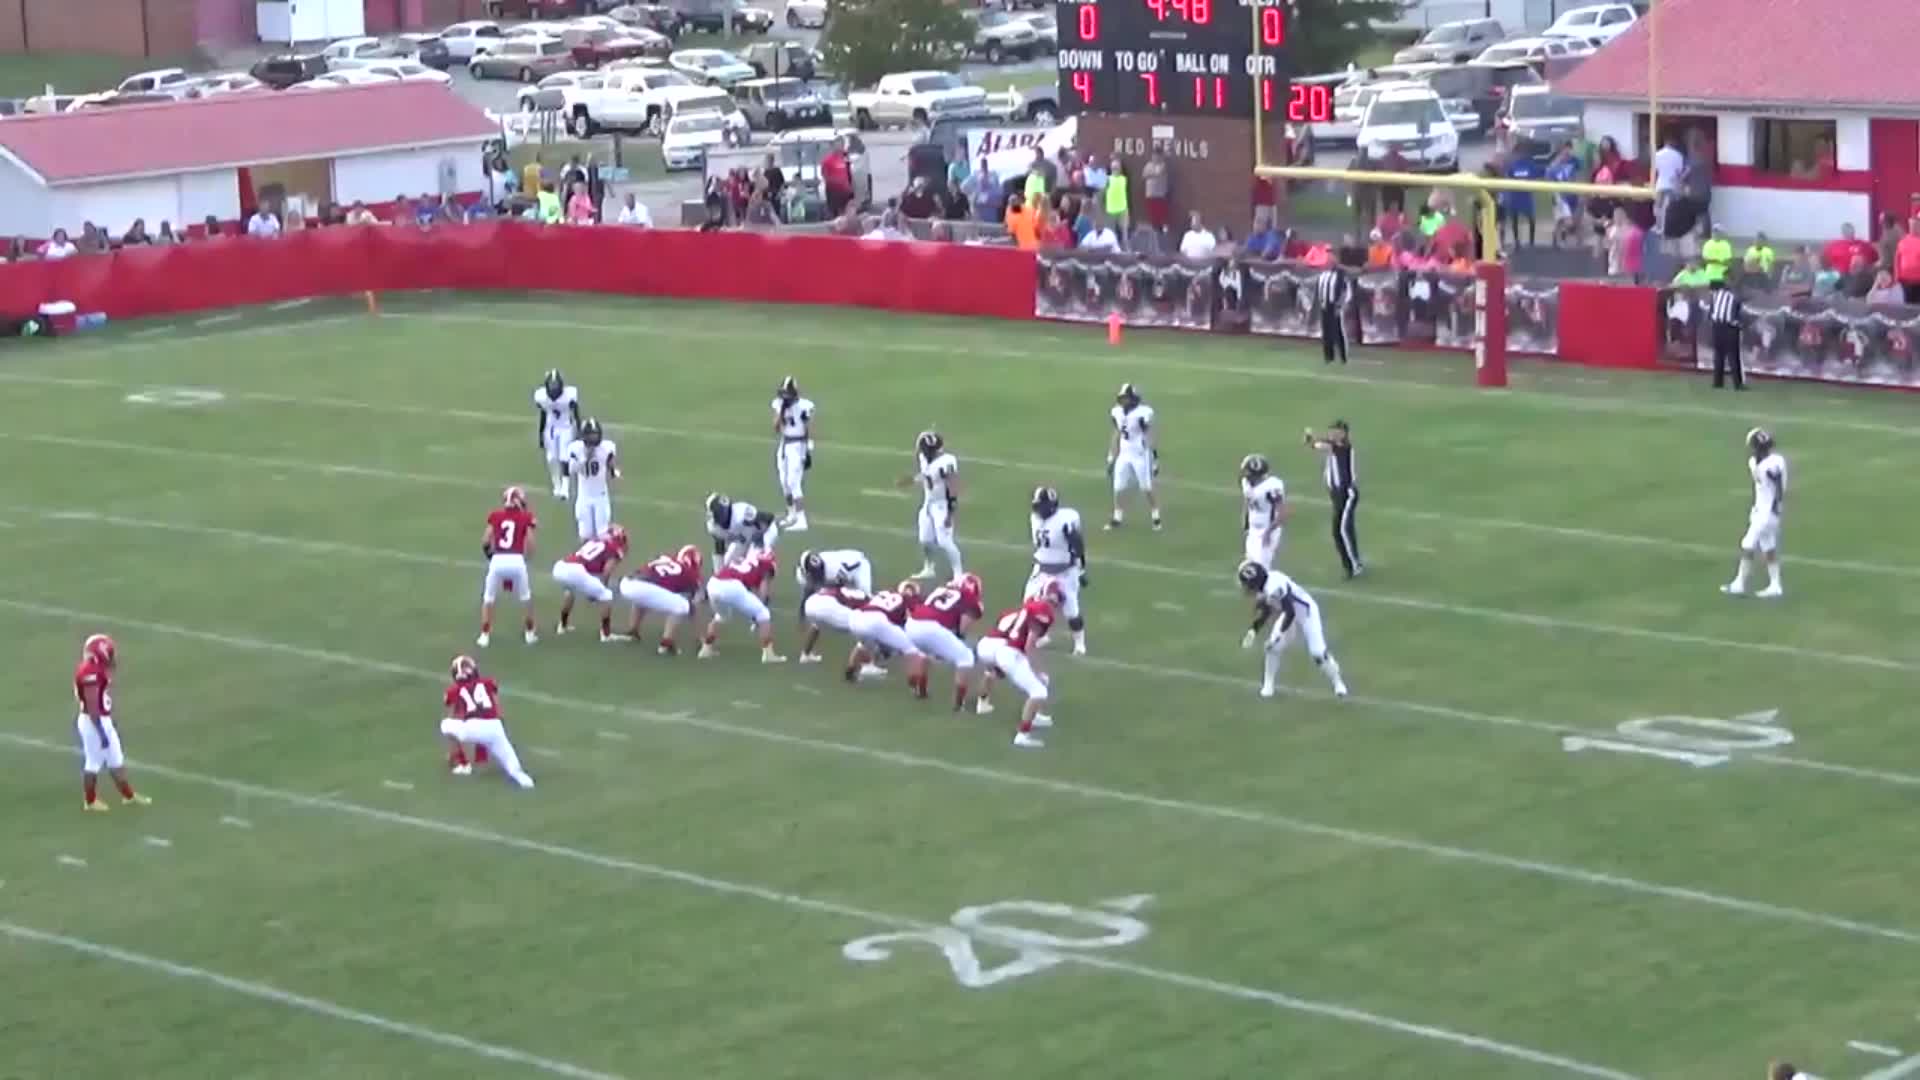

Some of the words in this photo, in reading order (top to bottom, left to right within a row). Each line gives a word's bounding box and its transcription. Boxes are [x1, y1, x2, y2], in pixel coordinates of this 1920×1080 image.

[1080, 5, 1096, 40] 0
[1263, 8, 1280, 44] 0
[1058, 49, 1103, 70] DOWN
[1115, 51, 1134, 71] TO
[1137, 52, 1158, 72] GO
[1175, 53, 1207, 73] BALL
[1209, 54, 1230, 74] ON
[1245, 55, 1276, 75] QTR
[1073, 72, 1090, 104] 4
[1140, 73, 1156, 105] 7
[1289, 85, 1327, 120] 20
[1114, 137, 1145, 156] RED
[500, 520, 515, 549] 3
[460, 683, 493, 712] 14
[843, 900, 1150, 988] 20
